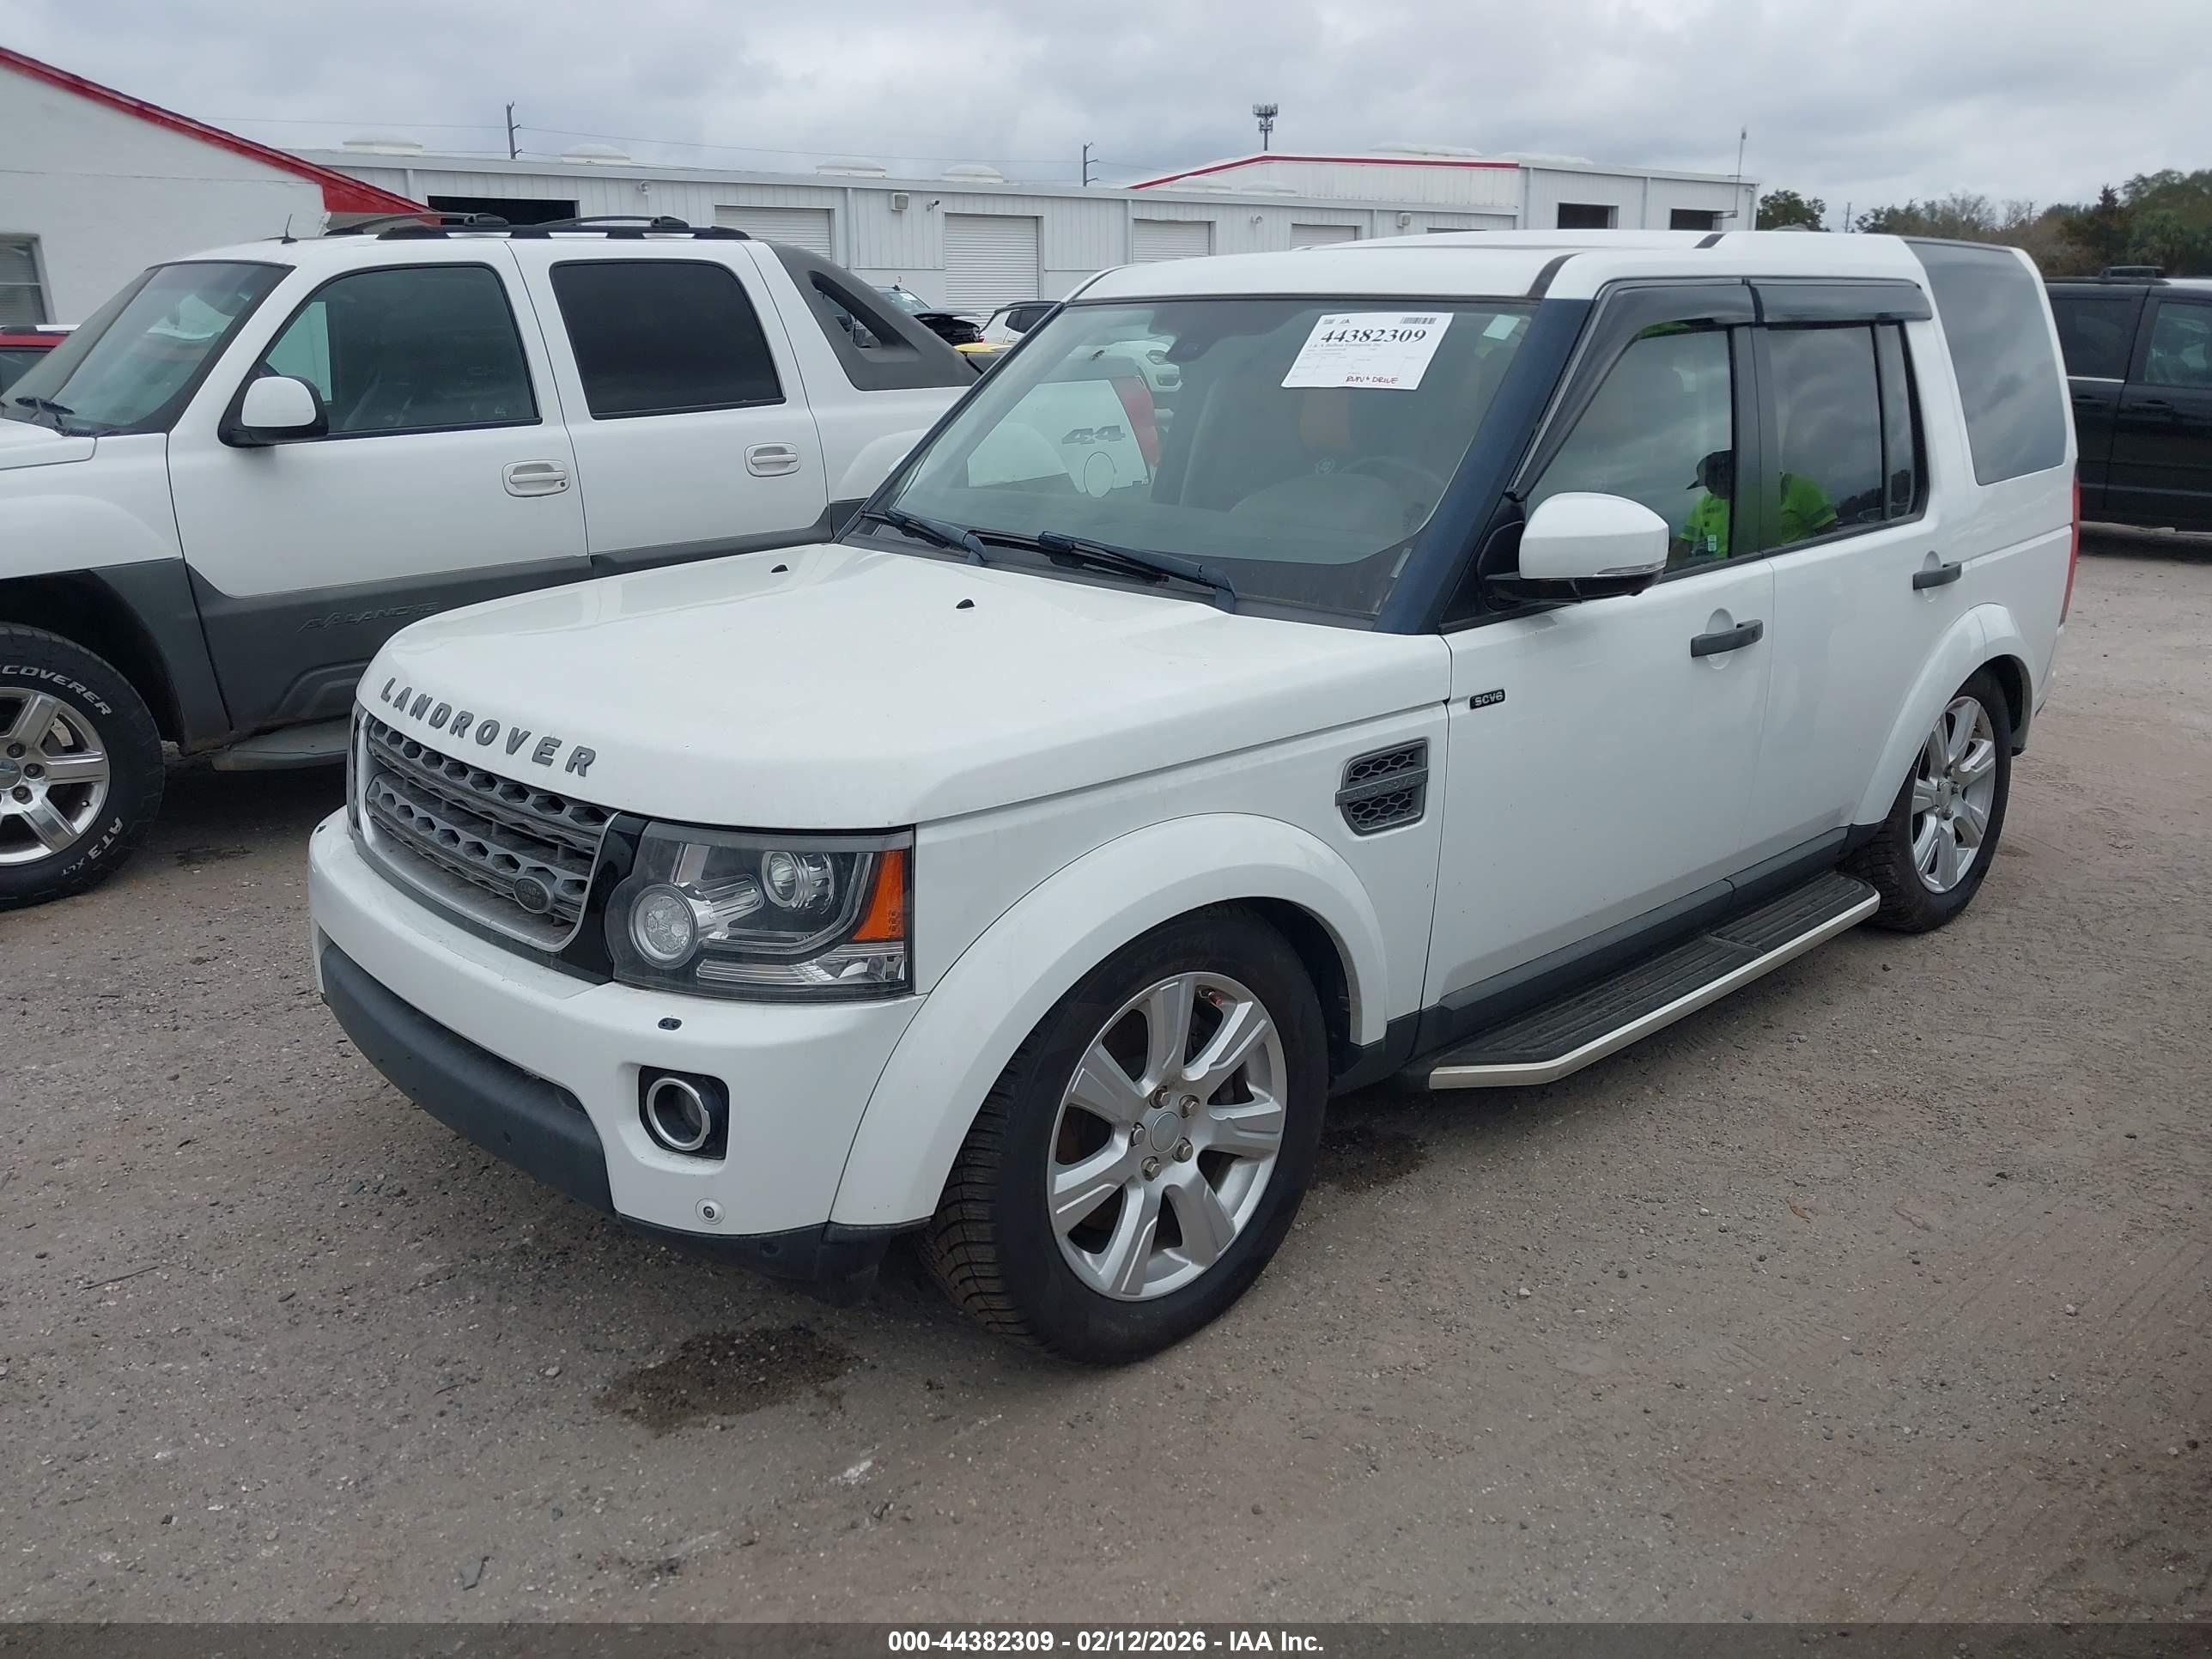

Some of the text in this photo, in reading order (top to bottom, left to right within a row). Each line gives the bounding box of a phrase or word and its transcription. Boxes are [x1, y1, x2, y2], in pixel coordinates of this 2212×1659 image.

[1321, 329, 1427, 343] 44382309
[1371, 376, 1399, 385] DRIVE
[0, 665, 112, 715] COVERER
[1474, 690, 1504, 707] SCV6
[88, 817, 124, 860] AT3
